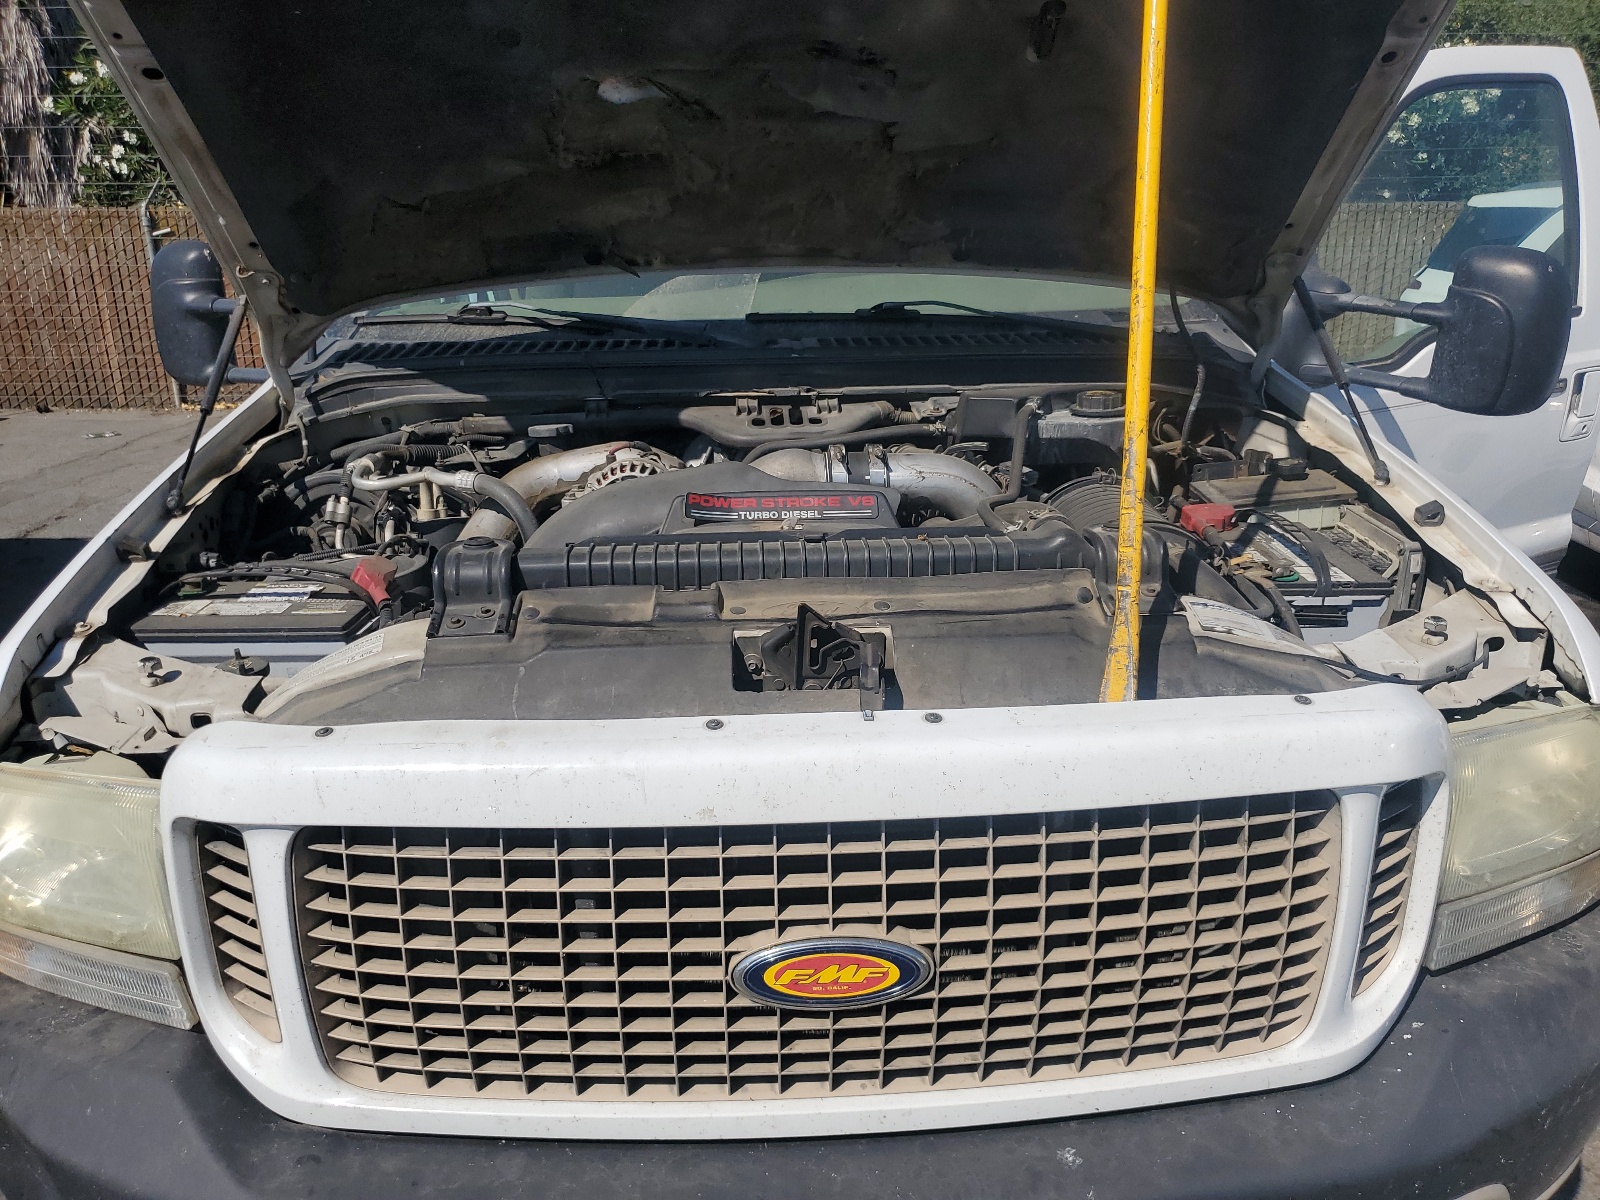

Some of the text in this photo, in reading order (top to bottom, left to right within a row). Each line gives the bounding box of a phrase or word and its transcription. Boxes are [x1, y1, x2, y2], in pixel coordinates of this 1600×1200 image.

[688, 493, 875, 509] POWER STROKE V8
[739, 510, 822, 520] TURBO DIESEL
[774, 964, 891, 986] FMF
